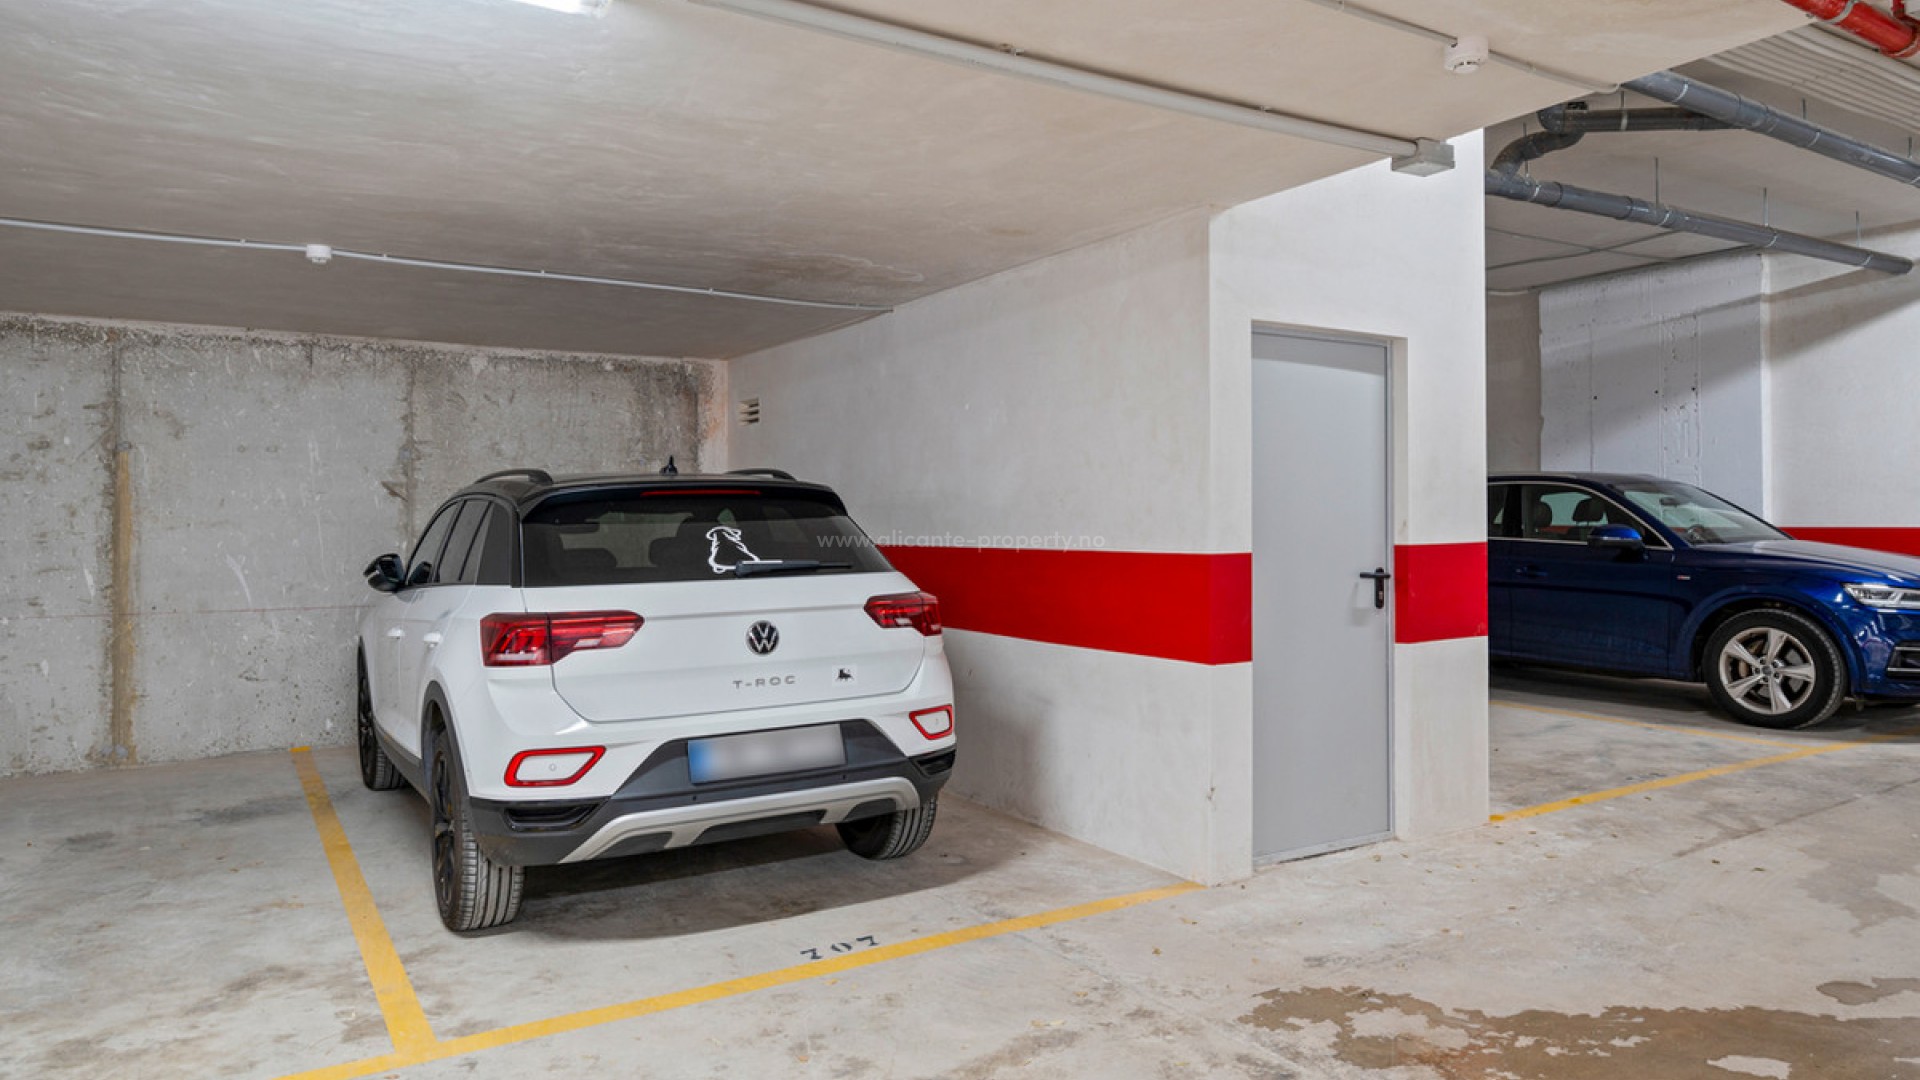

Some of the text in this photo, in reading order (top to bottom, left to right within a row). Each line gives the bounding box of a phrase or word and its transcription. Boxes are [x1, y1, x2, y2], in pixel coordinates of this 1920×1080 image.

[747, 621, 779, 655] VW
[732, 675, 796, 689] T-ROC
[799, 934, 879, 960] 707
